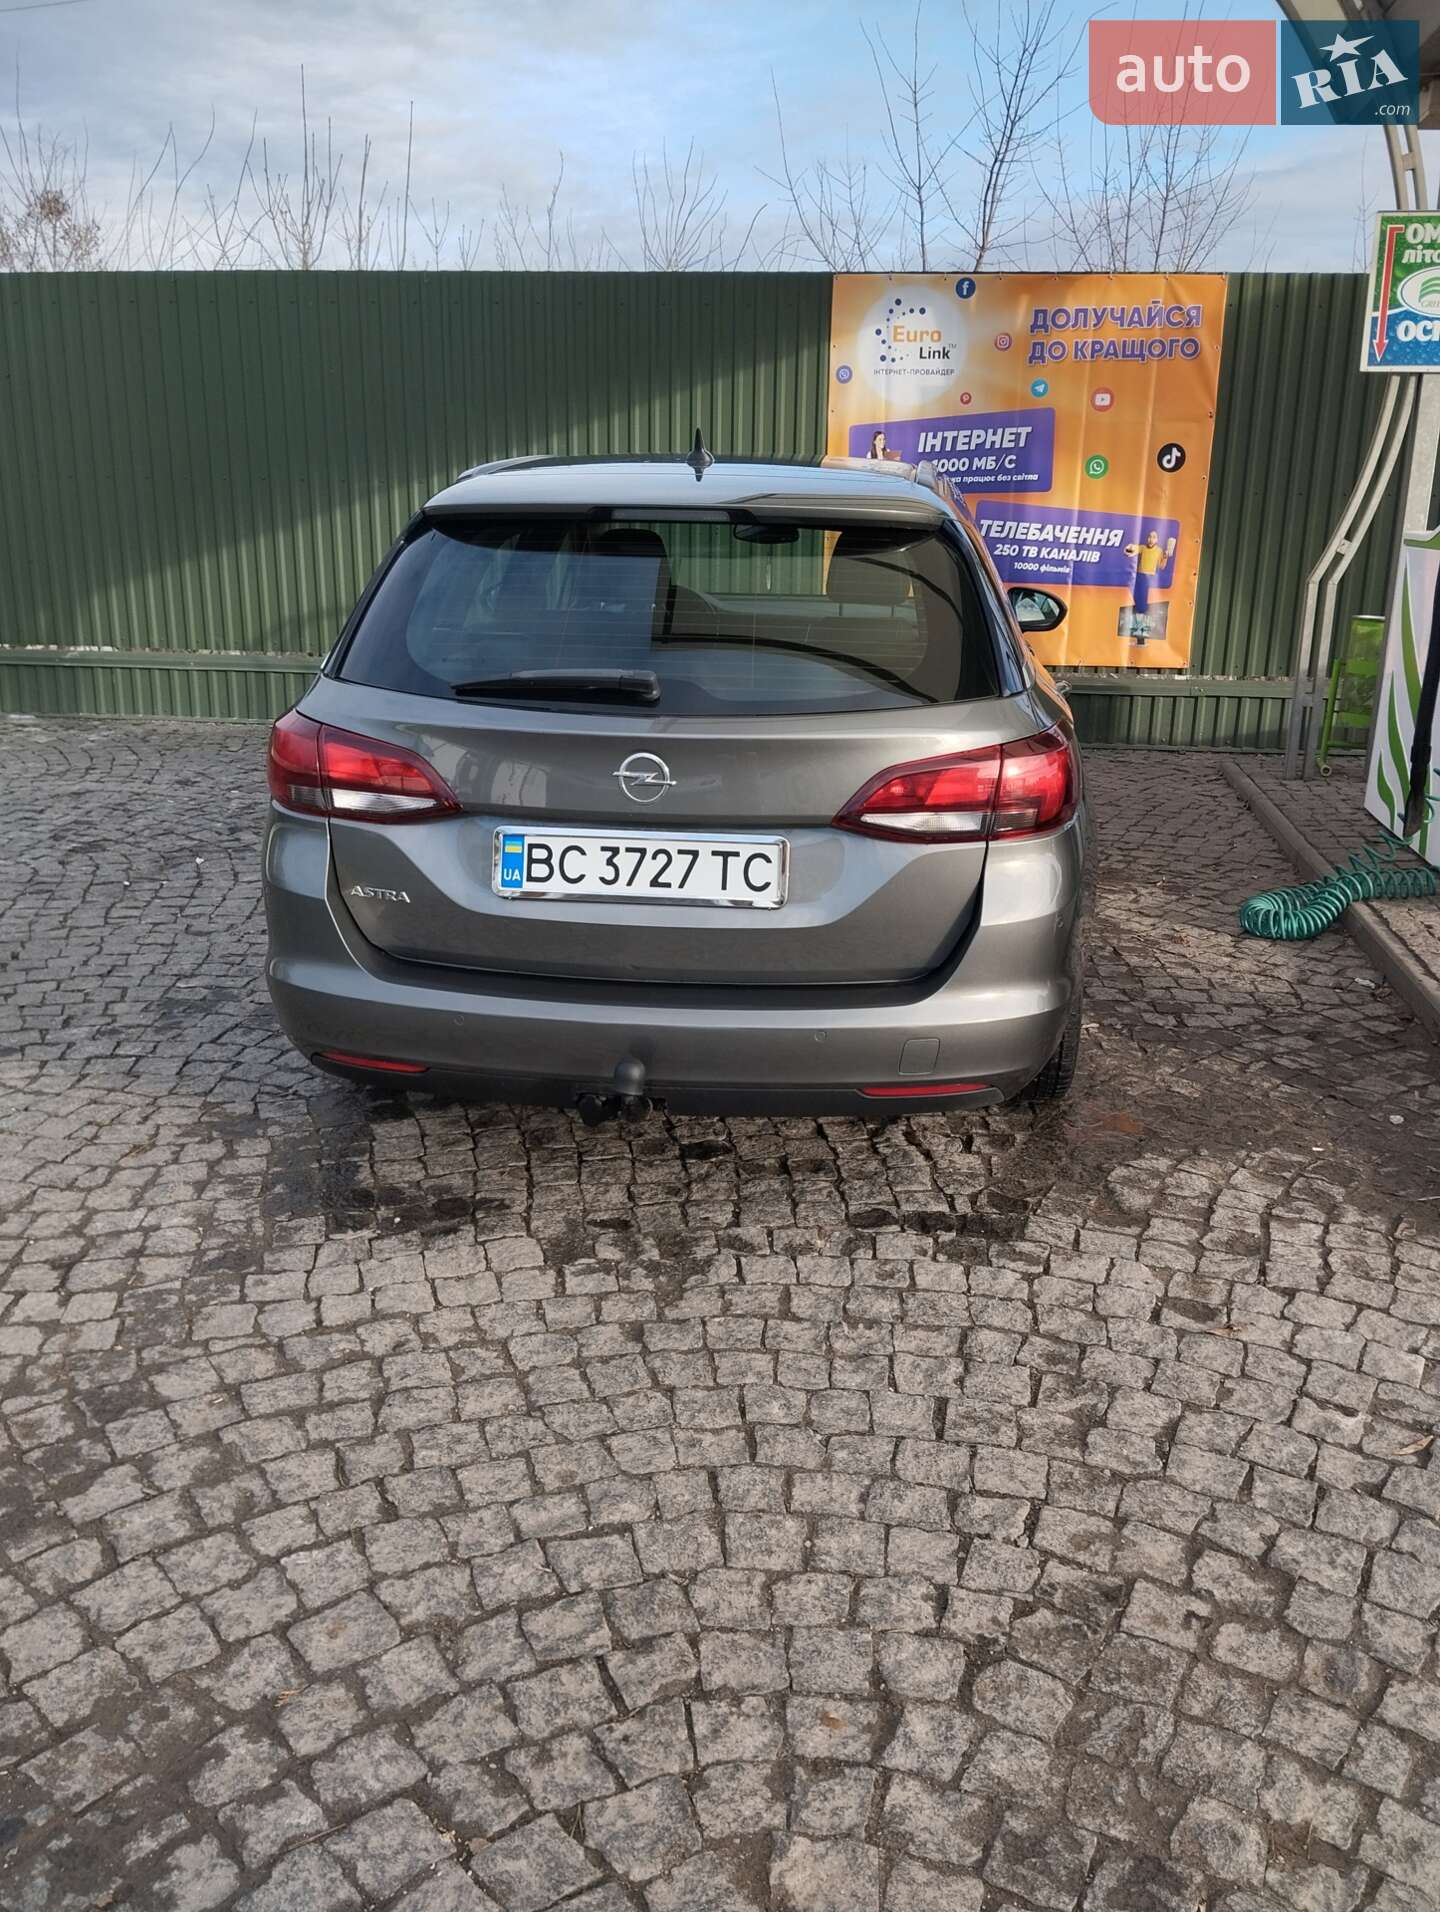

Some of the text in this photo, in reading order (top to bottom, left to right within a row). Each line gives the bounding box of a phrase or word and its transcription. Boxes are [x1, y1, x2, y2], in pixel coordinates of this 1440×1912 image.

[1029, 300, 1202, 335] ДОЛУЧАЙСЯ
[892, 324, 942, 343] Euro
[919, 346, 950, 360] Link
[1028, 337, 1201, 366] ДО КРАЩОГО
[873, 368, 955, 376] ІНТЕРНЕТ-ПРОВАЙДЕР
[917, 426, 1033, 453] ІНТЕРНЕТ
[972, 453, 1017, 472] МБ/С
[962, 474, 996, 483] працює
[998, 473, 1011, 481] без
[980, 519, 1124, 547] ТЕЛЕБАЧЕННЯ
[994, 544, 1101, 562] 250 ТВ КАНАЛІВ
[1014, 562, 1039, 571] 10000
[503, 843, 773, 892] UA BC 3727 TC
[351, 885, 411, 903] ASTRA
